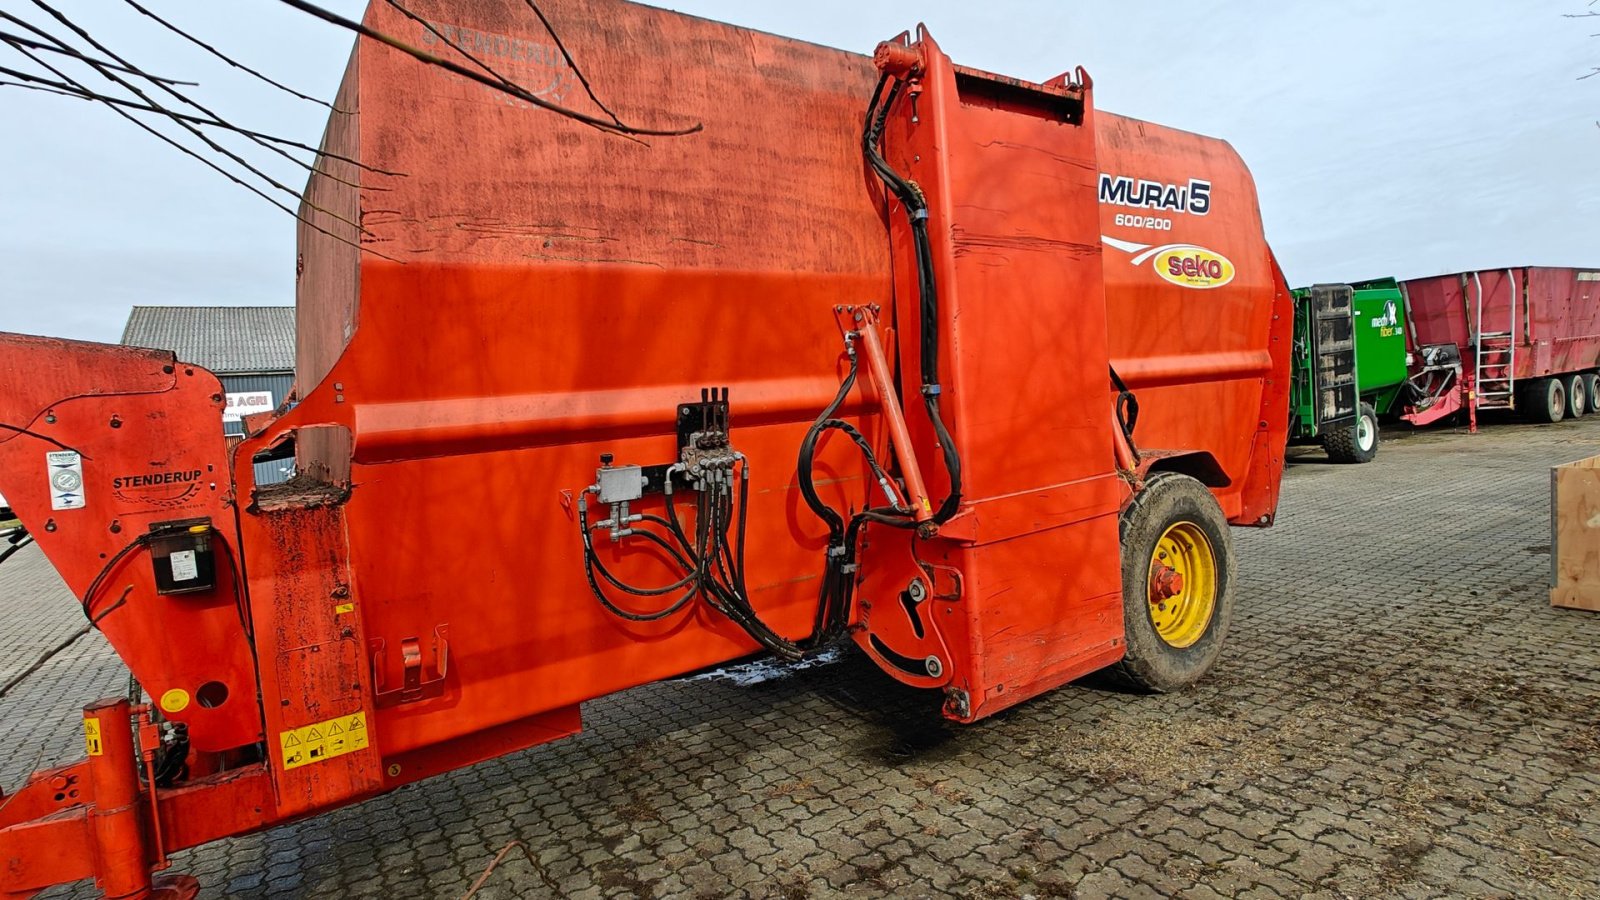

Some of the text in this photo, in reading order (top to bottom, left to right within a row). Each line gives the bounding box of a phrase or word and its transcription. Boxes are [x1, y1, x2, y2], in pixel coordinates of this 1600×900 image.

[1115, 213, 1172, 231] 600/200
[1168, 255, 1222, 278] seko
[237, 395, 268, 407] AGRI
[113, 469, 202, 489] STENDERUP
